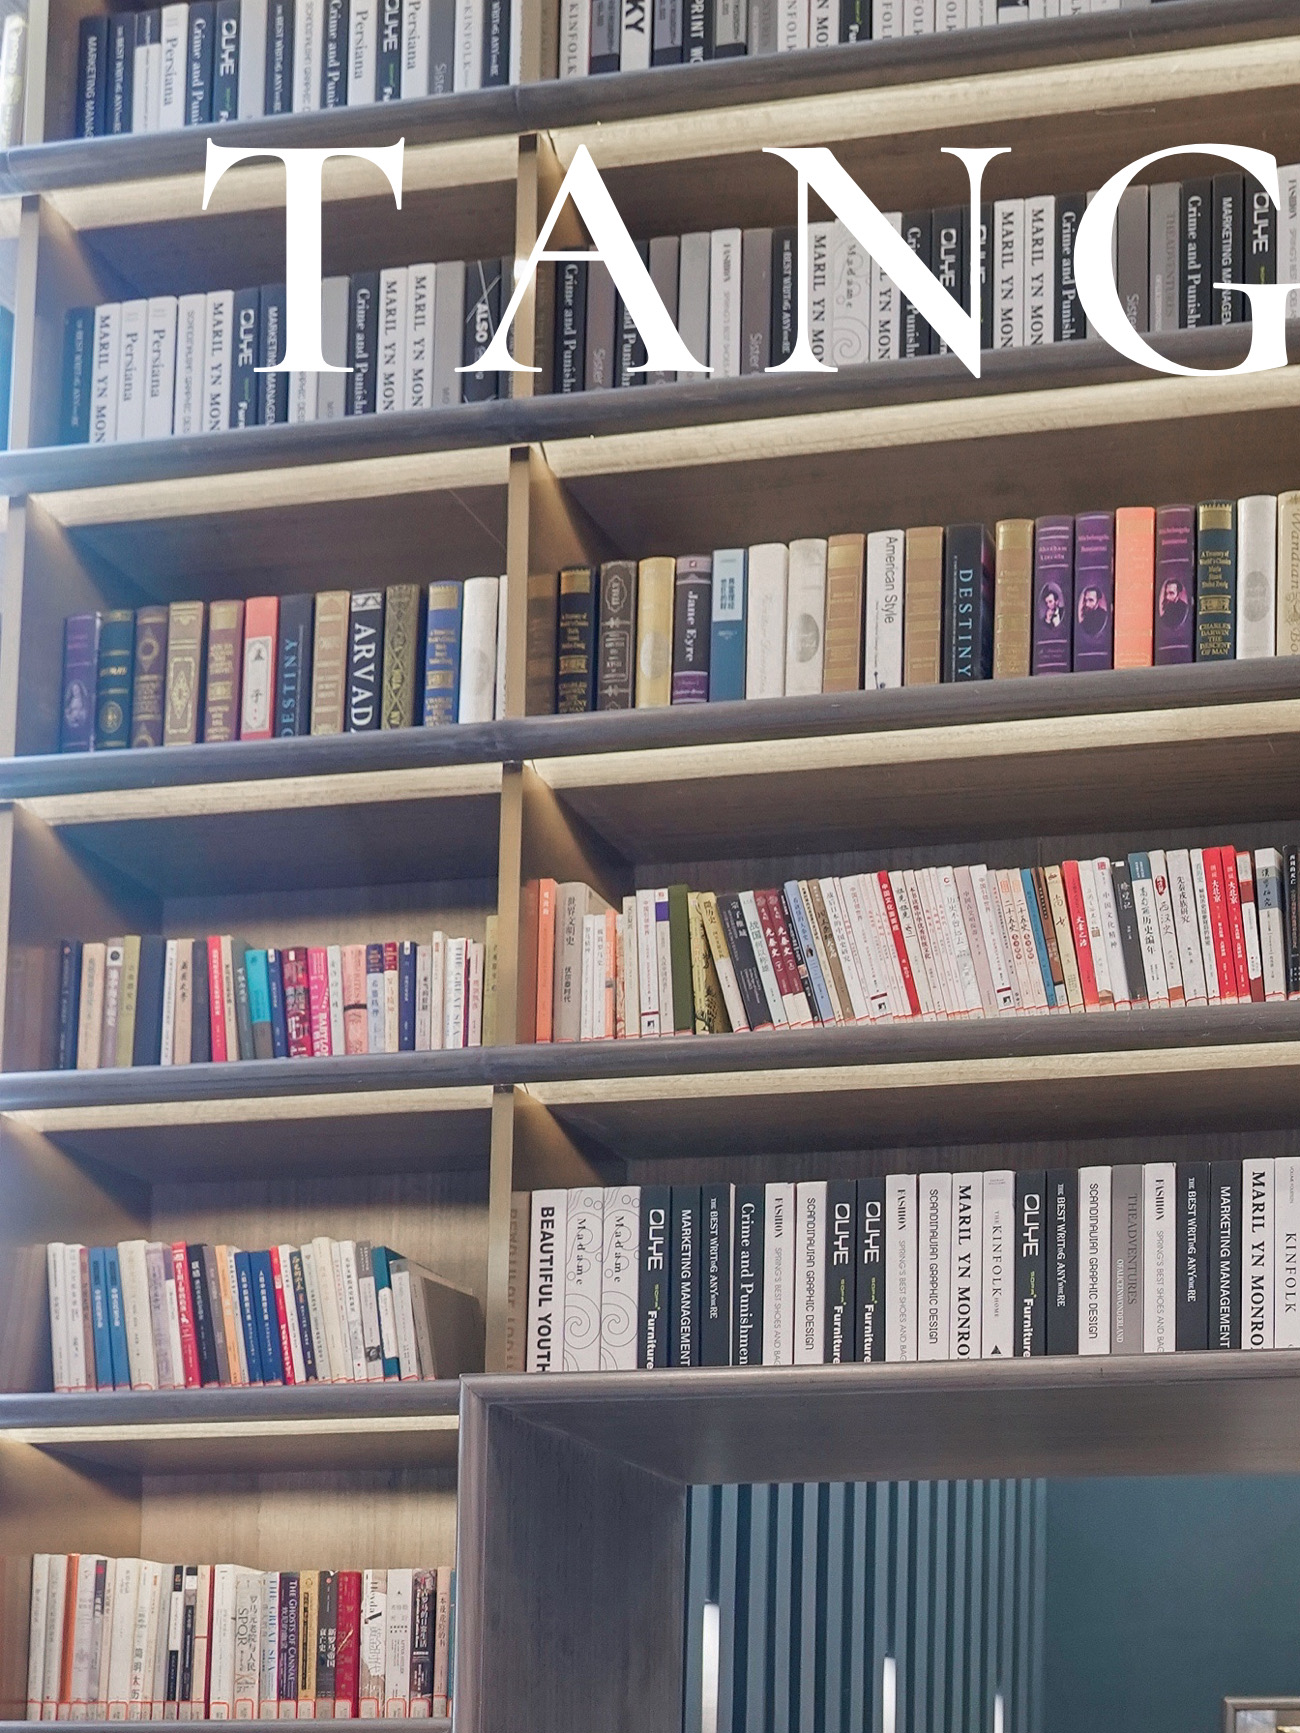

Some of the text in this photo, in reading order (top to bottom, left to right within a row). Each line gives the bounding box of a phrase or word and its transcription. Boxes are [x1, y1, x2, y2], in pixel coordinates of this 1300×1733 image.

[164, 38, 179, 105] Persiana
[354, 10, 368, 79] Persiana
[1001, 211, 1015, 300] MARIL YN
[1031, 209, 1045, 298] MARIL YN
[1188, 196, 1202, 271] Crime and
[1222, 196, 1233, 267] MARKETING
[357, 288, 371, 324] Crime
[565, 264, 579, 306] Crime
[813, 235, 827, 322] MARIL YN
[211, 303, 224, 386] MARIL YN
[384, 281, 397, 366] MARIL YN
[413, 276, 427, 361] MARIL YN
[96, 315, 110, 398] MARIL YN
[124, 332, 138, 402] Persiana
[151, 329, 165, 399] Persiana
[884, 536, 898, 624] American Style
[685, 591, 698, 662] Jane Eyre
[958, 568, 973, 677] DESTINY
[1005, 899, 1019, 934] 二十五史
[1017, 898, 1031, 933] 二十五史
[741, 1202, 755, 1247] Crime
[1155, 1179, 1164, 1221] FASHION
[538, 1206, 555, 1307] BEAUTIFUL
[613, 1216, 625, 1283] Madame
[740, 1250, 755, 1279] and
[956, 1185, 971, 1359] MARIL YN MONRO
[991, 1225, 1002, 1297] KINFOLK
[1089, 1256, 1099, 1301] GRAPHIC
[1219, 1186, 1231, 1348] MARKETING MANAGEMENT
[1249, 1172, 1266, 1349] MARIL YN MONRO
[1285, 1233, 1297, 1312] KINFOLK
[679, 1209, 692, 1366] MARKETING MANAGEMENT
[806, 1264, 815, 1312] GRAPHIC
[929, 1263, 938, 1307] GRAPHIC
[646, 1310, 657, 1370] Furniture
[805, 1314, 814, 1350] DESIGN
[833, 1305, 843, 1364] Furniture
[863, 1304, 874, 1362] Furniture
[929, 1309, 938, 1344] DESIGN
[1022, 1298, 1034, 1358] Furniture
[1088, 1303, 1098, 1339] DESIGN
[288, 1580, 297, 1598] THE
[288, 1599, 297, 1633] GHOSTS
[237, 1608, 248, 1646] SPQR
[288, 1646, 297, 1681] CANNAE
